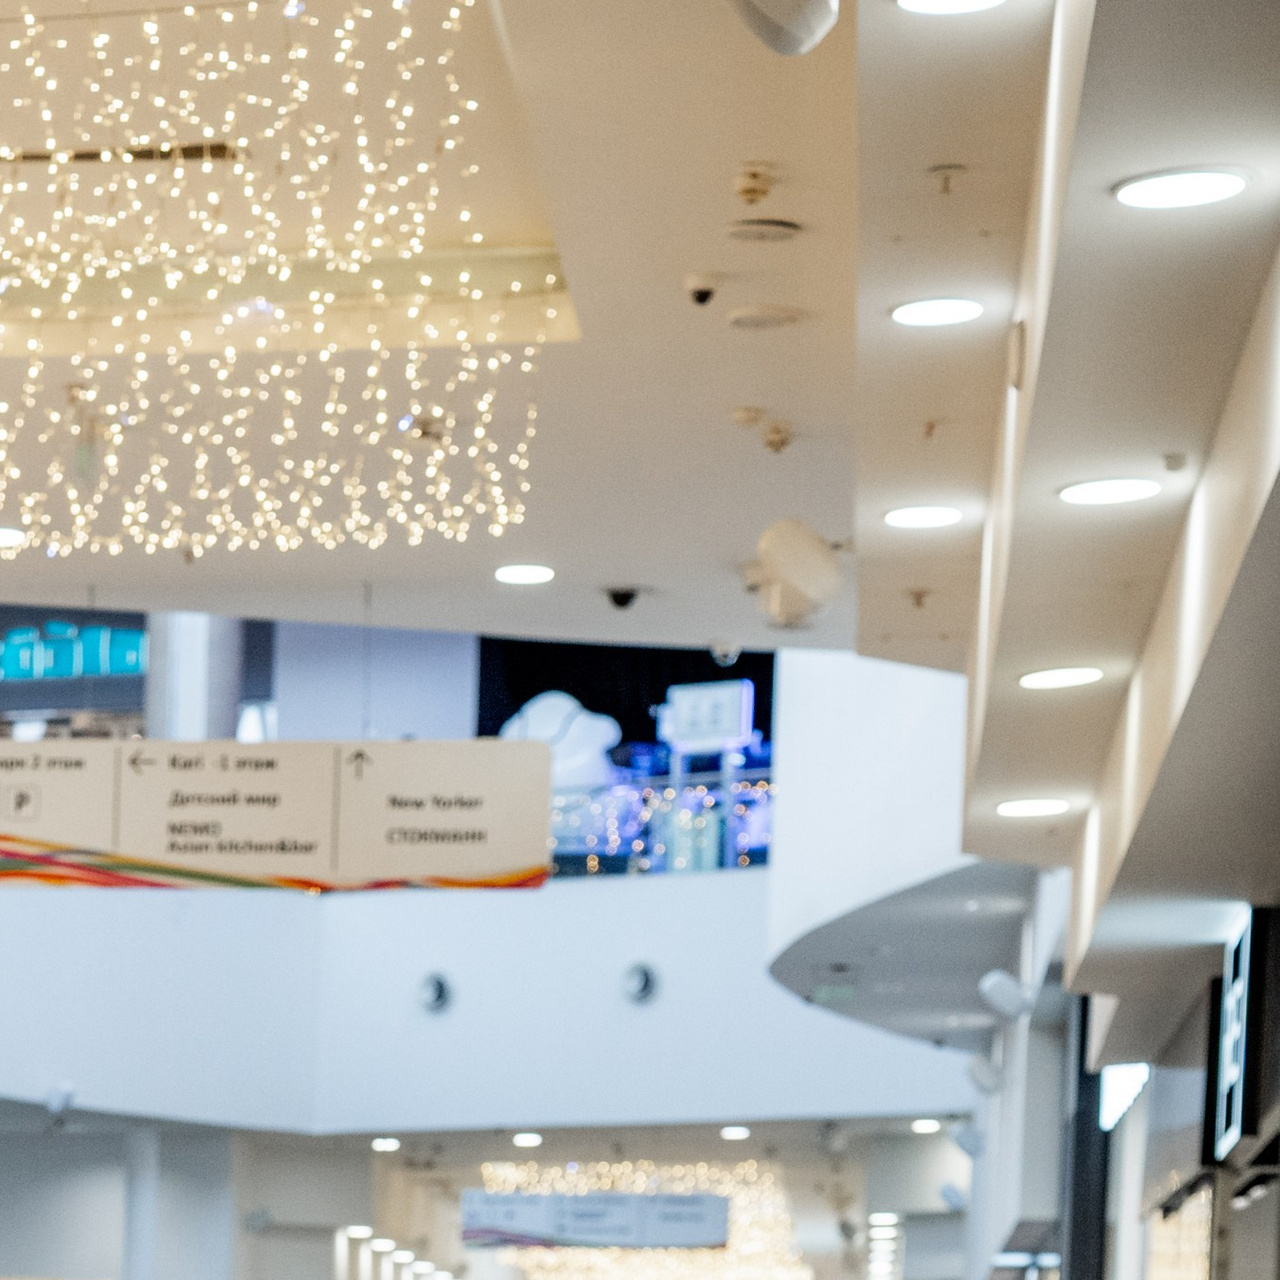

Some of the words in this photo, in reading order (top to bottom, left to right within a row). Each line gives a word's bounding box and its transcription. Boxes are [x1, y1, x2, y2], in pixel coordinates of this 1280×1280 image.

[45, 756, 86, 771] этаж
[234, 756, 277, 771] этаж
[169, 788, 239, 807] Детский
[243, 792, 280, 808] мир
